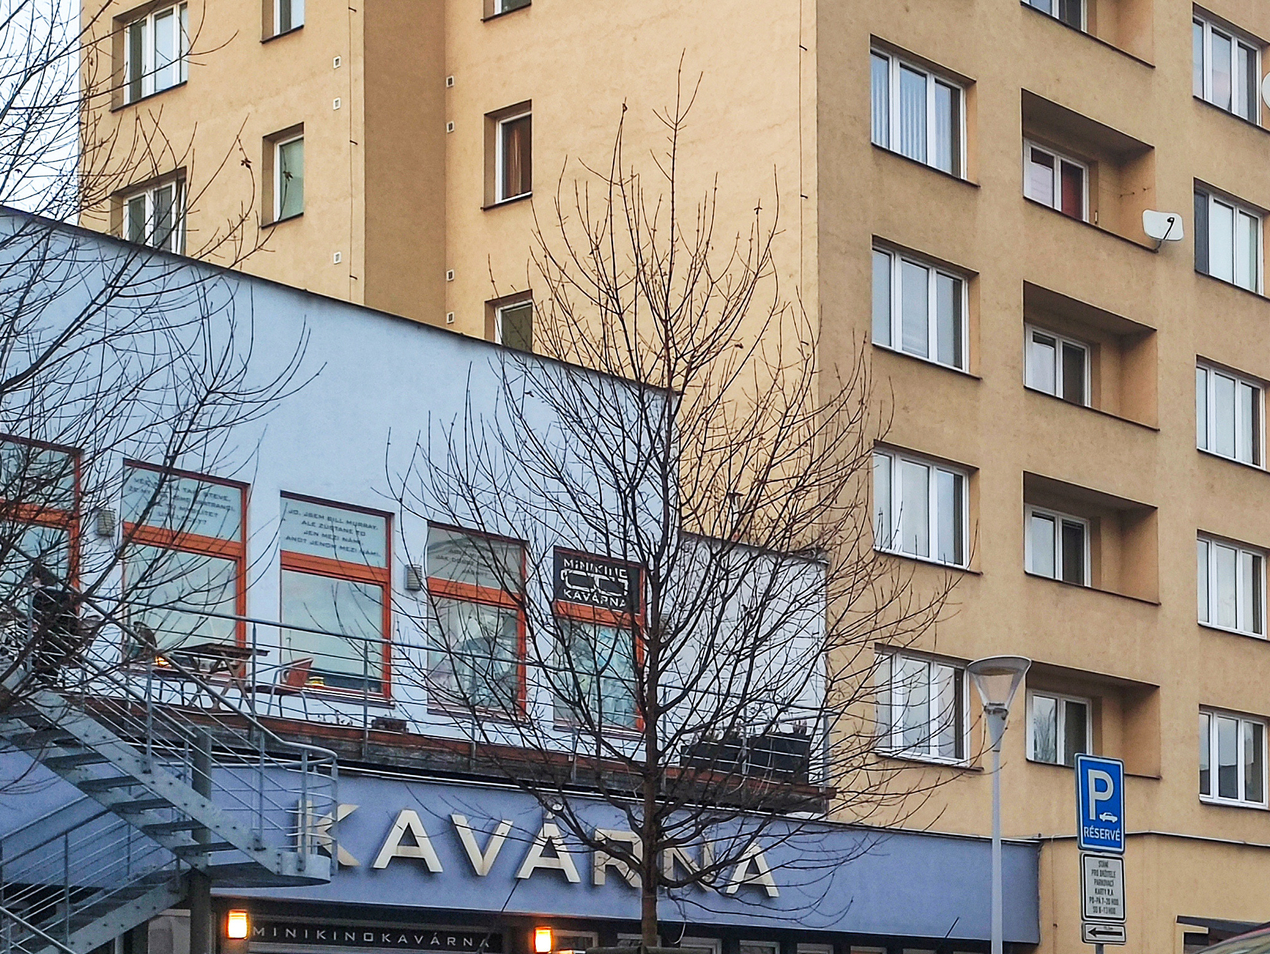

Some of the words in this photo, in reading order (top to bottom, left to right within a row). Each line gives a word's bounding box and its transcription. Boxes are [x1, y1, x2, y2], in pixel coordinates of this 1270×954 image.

[327, 516, 344, 524] BILL
[1087, 769, 1115, 821] P
[1083, 825, 1121, 843] RÉSERVÉ
[296, 798, 781, 898] KAVÁRNA
[252, 926, 491, 949] MINIKINOKAVÁRNA
